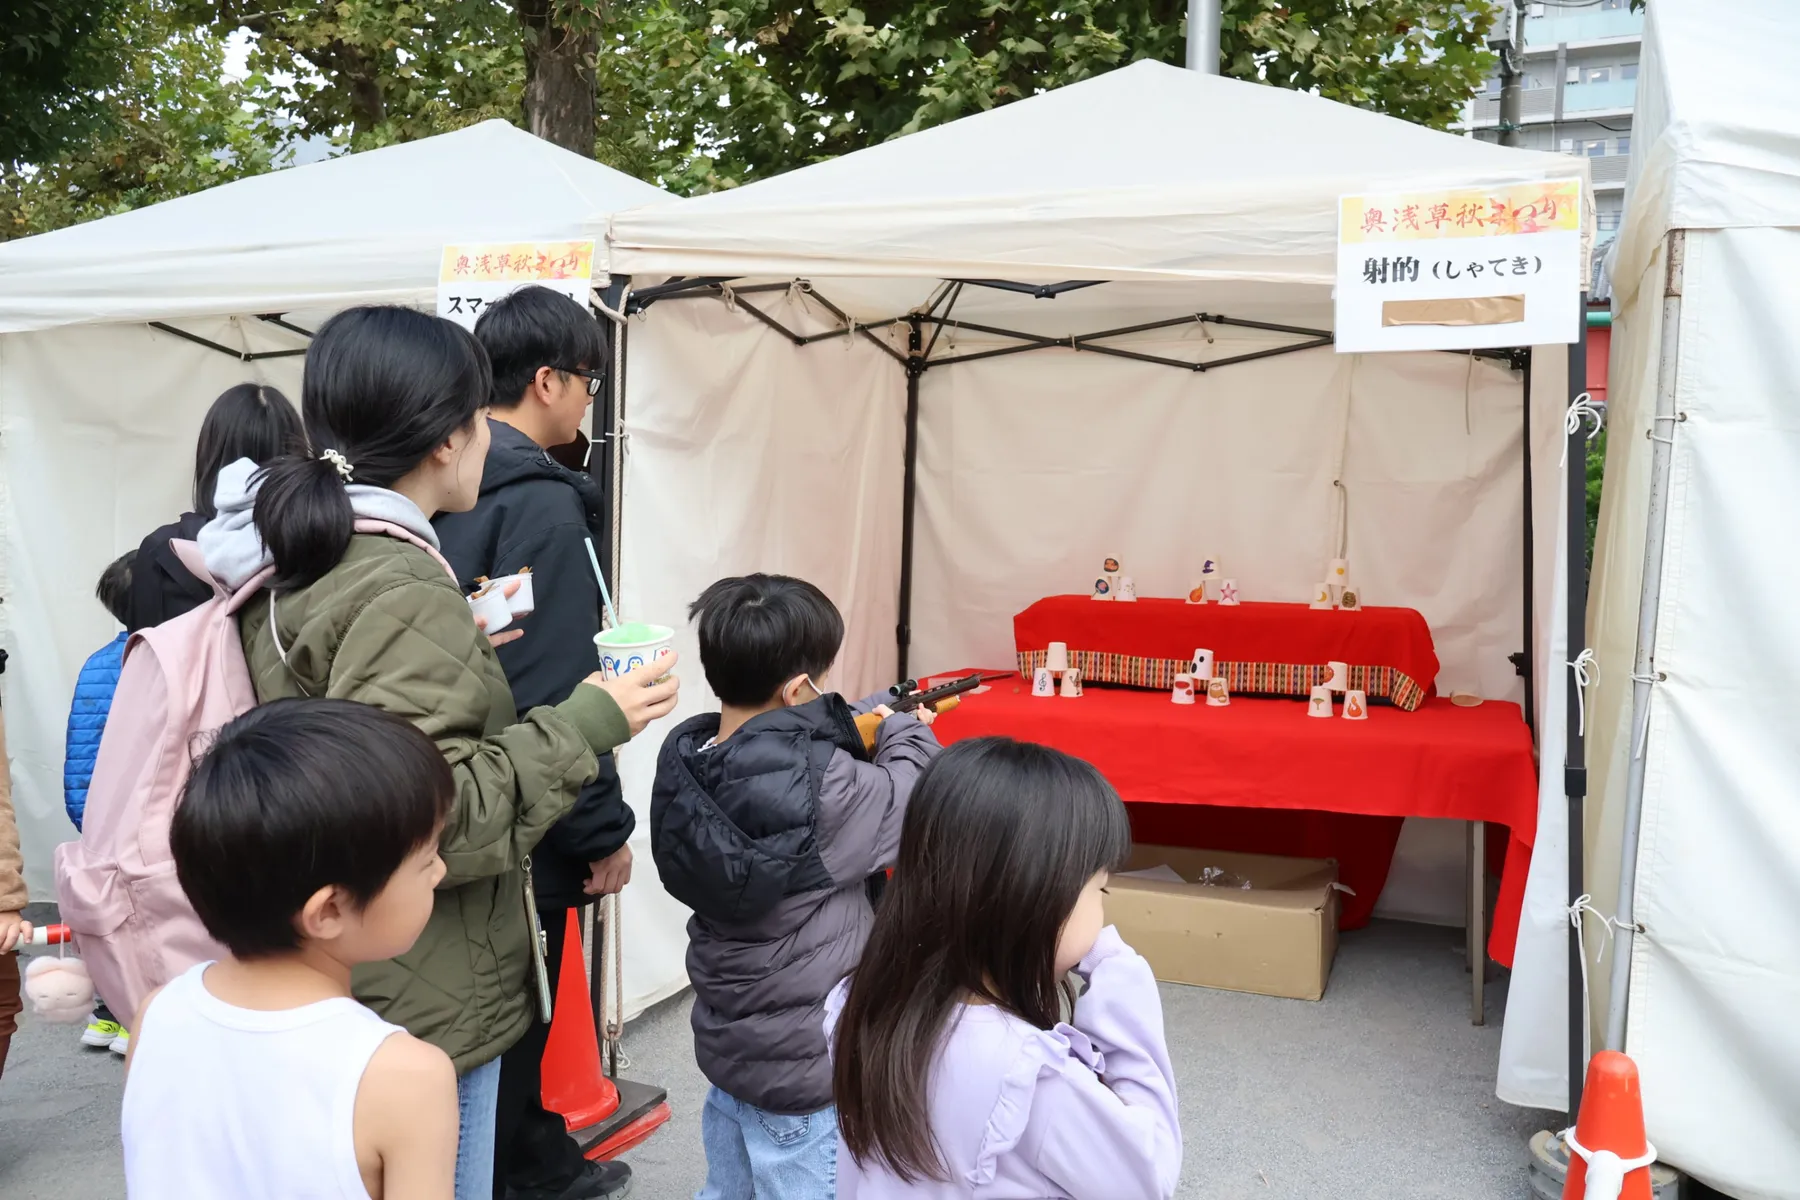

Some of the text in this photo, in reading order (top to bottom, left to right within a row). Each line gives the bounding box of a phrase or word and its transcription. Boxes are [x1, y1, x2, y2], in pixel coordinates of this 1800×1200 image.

[1360, 197, 1558, 234] 奥浅草秋まつり
[453, 253, 579, 276] 奥浅草秋まつり
[1362, 255, 1543, 285] 射的（しゃてき）
